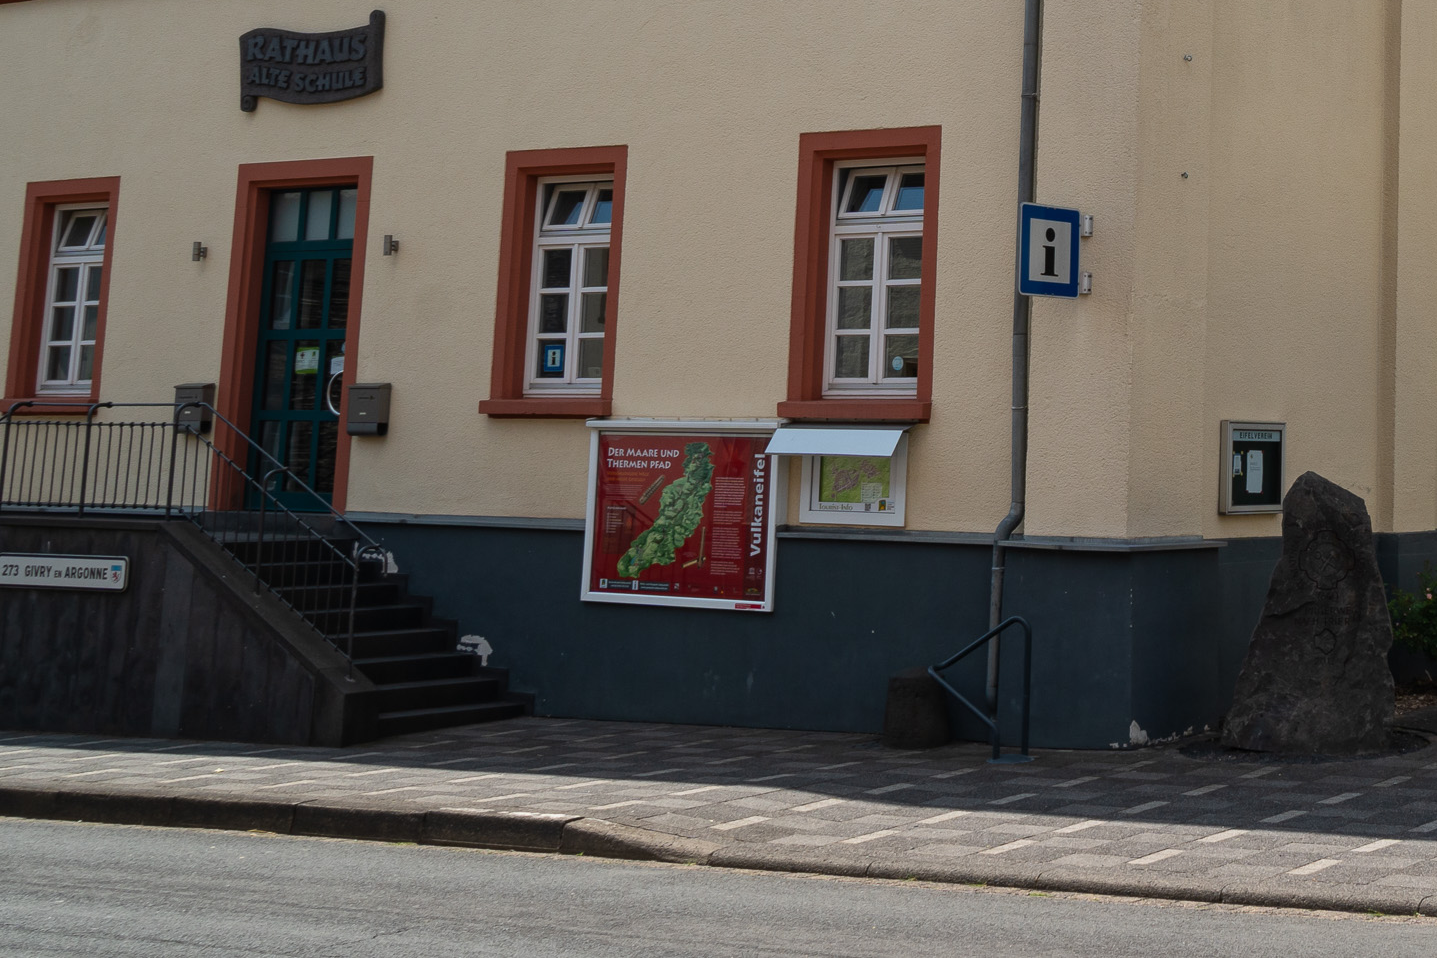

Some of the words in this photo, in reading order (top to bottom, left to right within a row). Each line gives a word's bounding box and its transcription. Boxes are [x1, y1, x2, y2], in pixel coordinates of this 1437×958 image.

[247, 36, 367, 64] RATHAUS
[247, 66, 292, 88] ALTE
[294, 68, 367, 92] SCHULE
[1040, 227, 1059, 277] i
[1239, 431, 1273, 439] EIFELVEREIN
[608, 447, 625, 457] DER
[626, 448, 659, 457] MAARE
[660, 449, 680, 458] UND
[607, 458, 648, 468] THERMEN
[650, 460, 672, 469] PFAD
[749, 453, 766, 557] Vulkaneifel
[1, 564, 20, 577] 273
[24, 565, 53, 578] GIVRY
[54, 569, 63, 578] EN
[64, 566, 109, 580] ARGONNE
